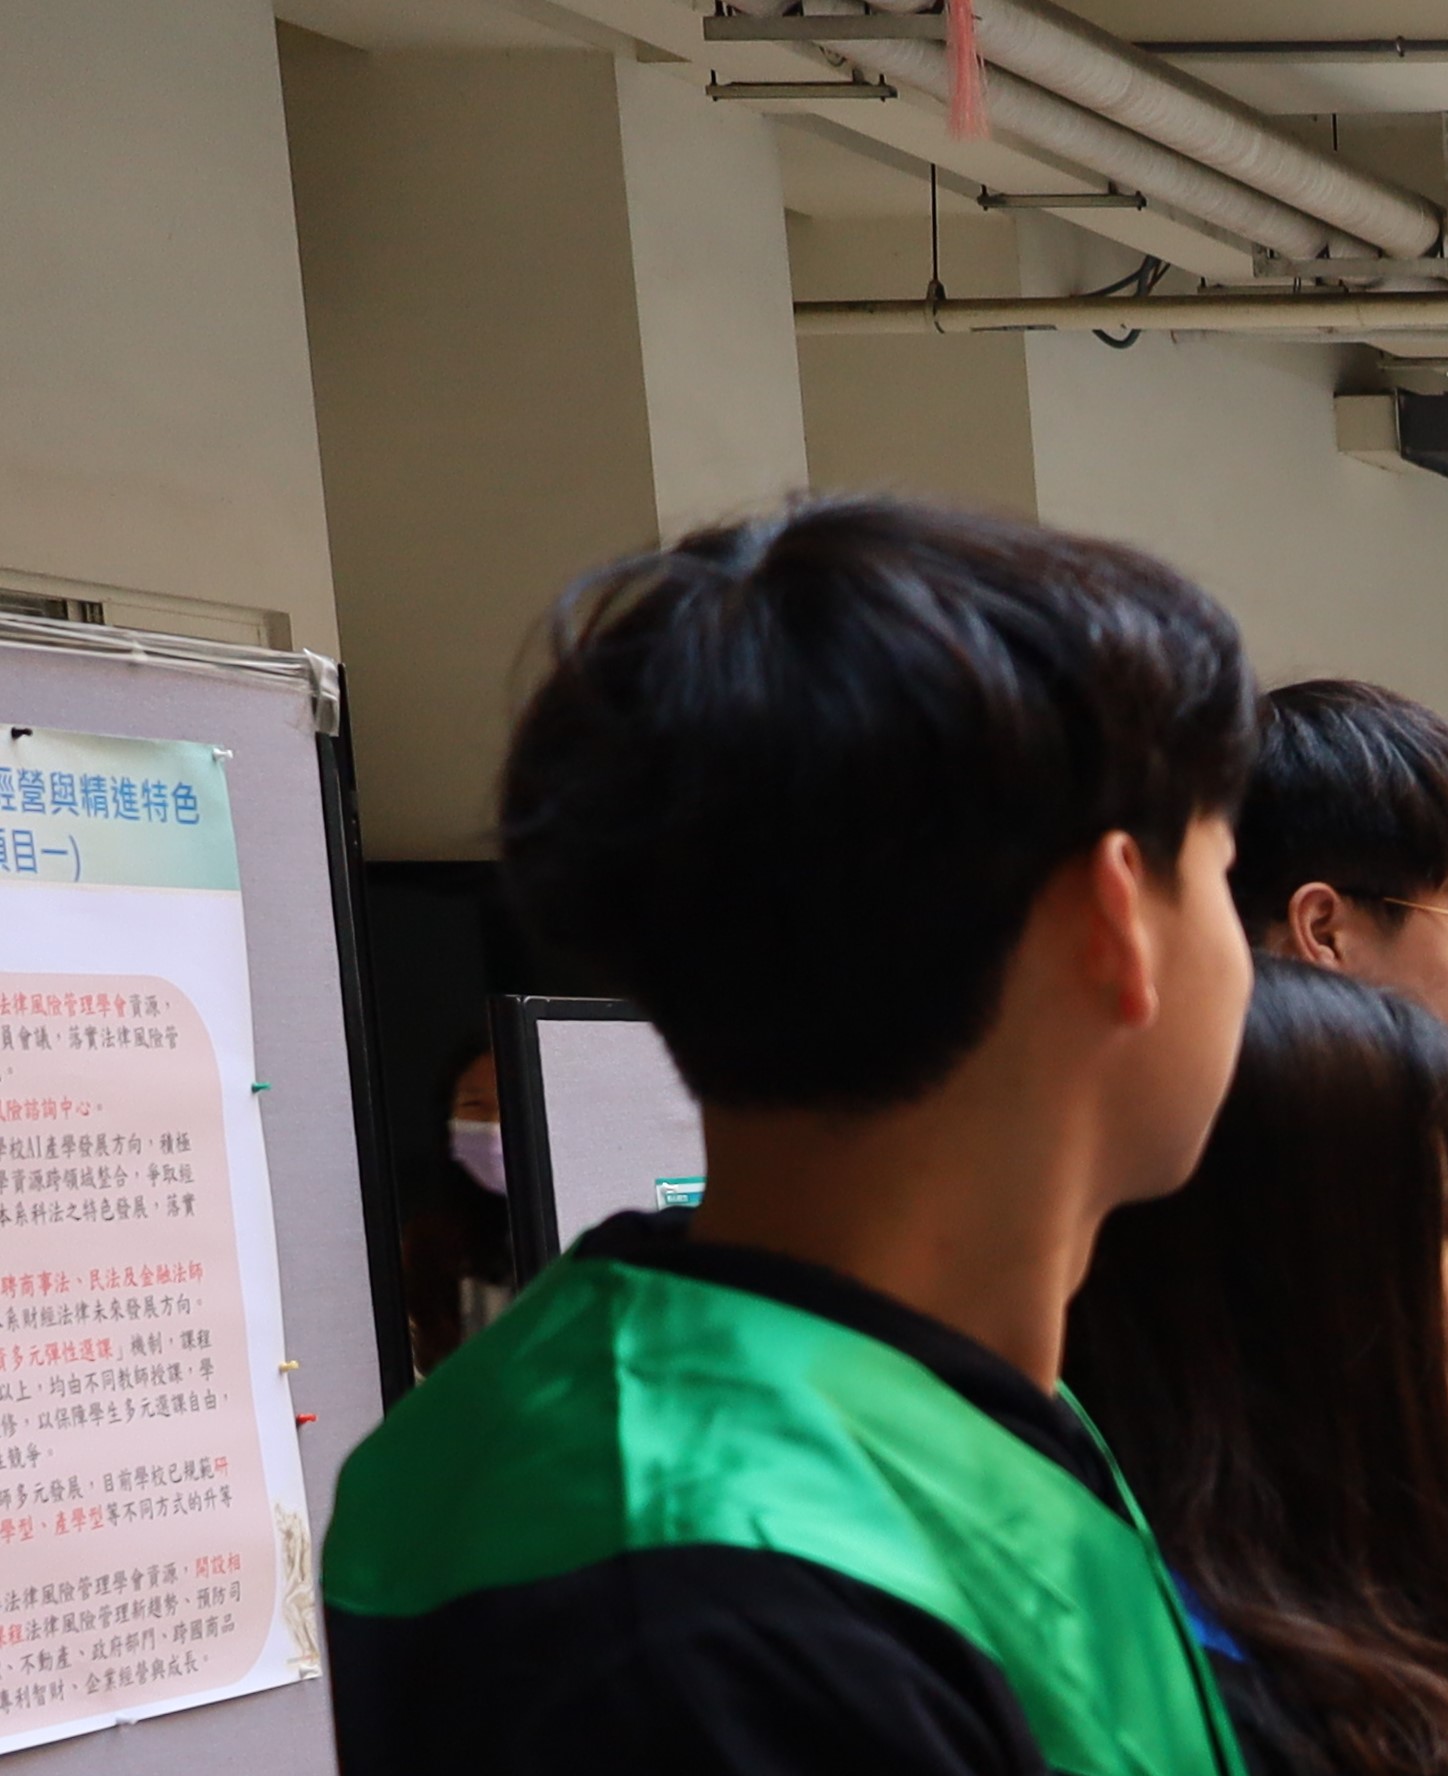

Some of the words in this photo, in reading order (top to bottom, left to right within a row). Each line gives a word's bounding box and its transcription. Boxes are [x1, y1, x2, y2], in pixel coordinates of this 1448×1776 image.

[0, 1097, 103, 1121] 險諮詢中心。
[0, 1443, 54, 1470] 競爭。
